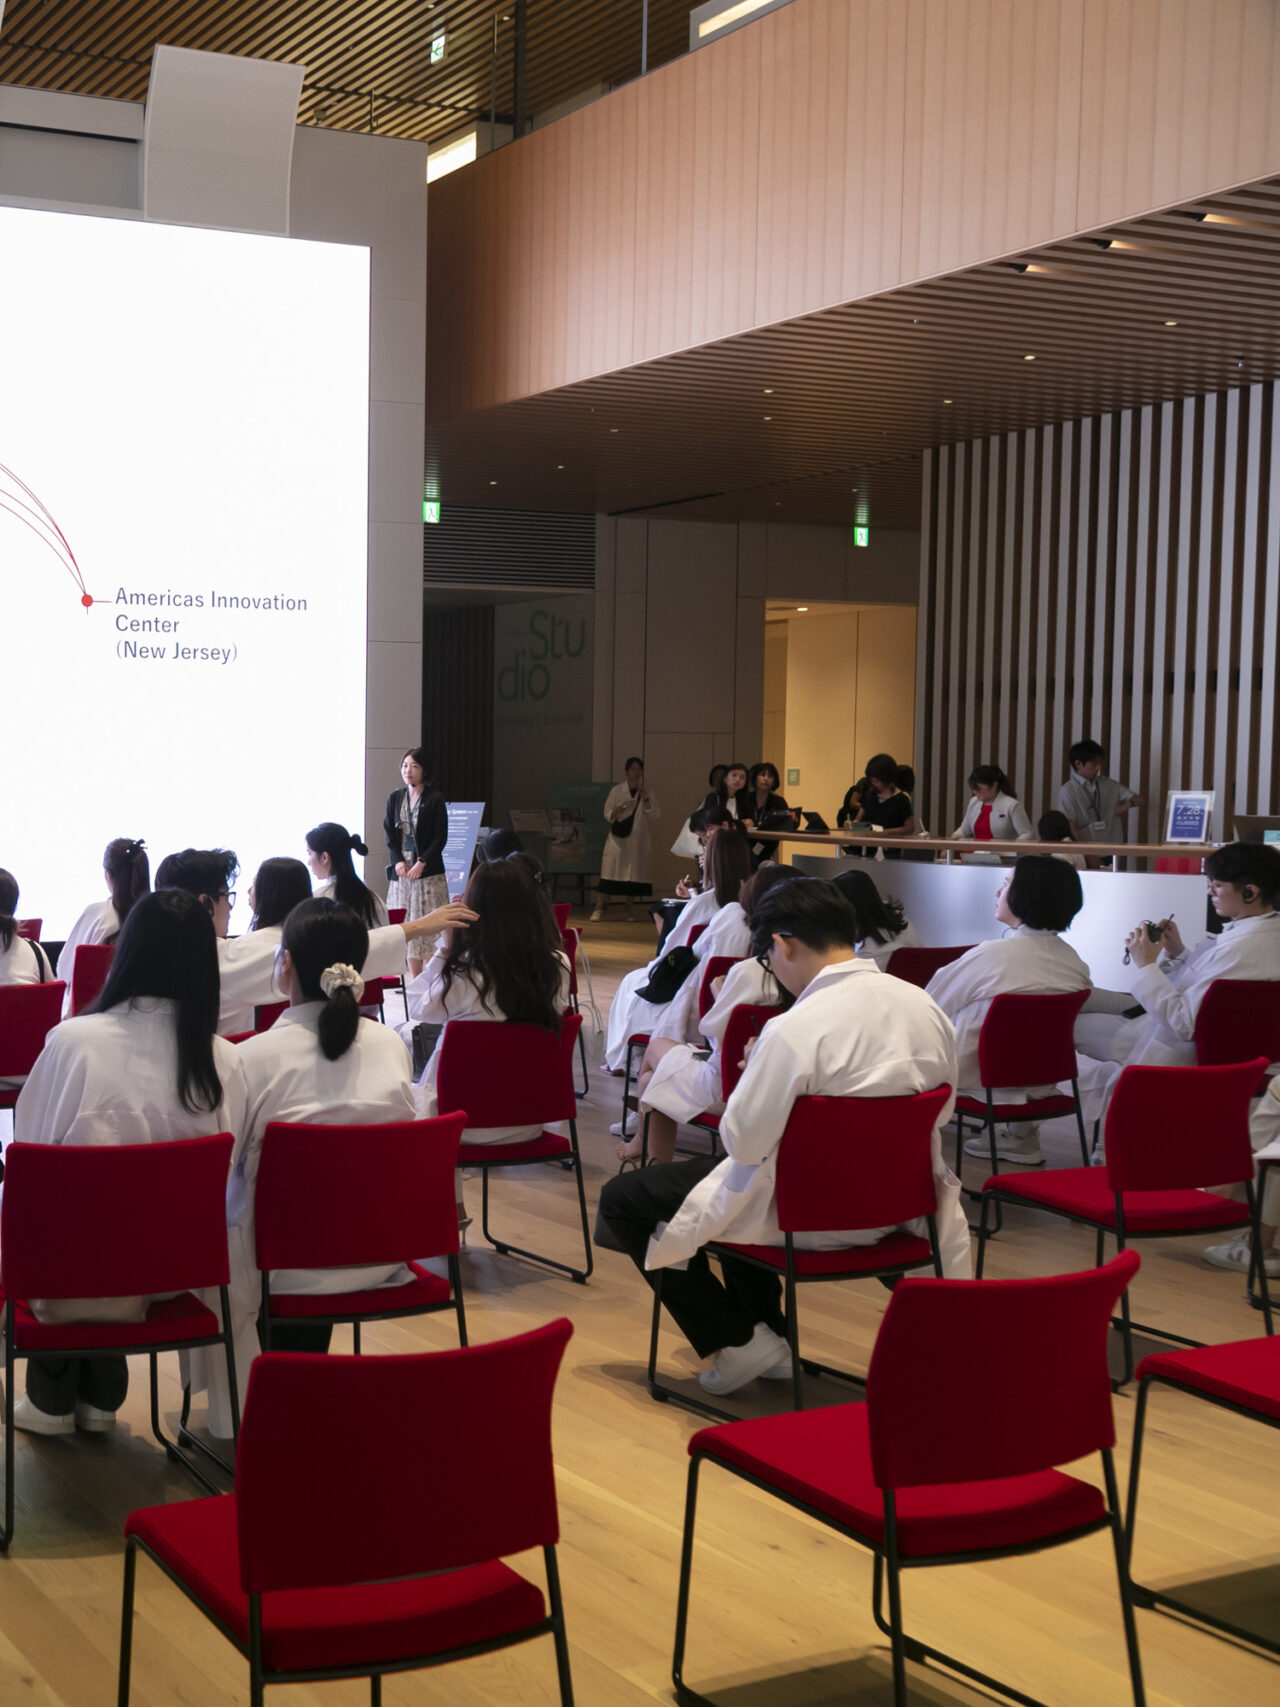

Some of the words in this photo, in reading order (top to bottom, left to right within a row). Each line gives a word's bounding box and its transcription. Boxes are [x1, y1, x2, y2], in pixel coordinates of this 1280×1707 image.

[116, 587, 204, 607] Americas
[212, 591, 307, 611] Innovation
[116, 614, 179, 633] Center
[528, 609, 586, 661] Stu
[117, 640, 166, 659] (New
[172, 642, 237, 665] Jersey)
[497, 648, 551, 703] dio
[1176, 805, 1201, 815] 7.28
